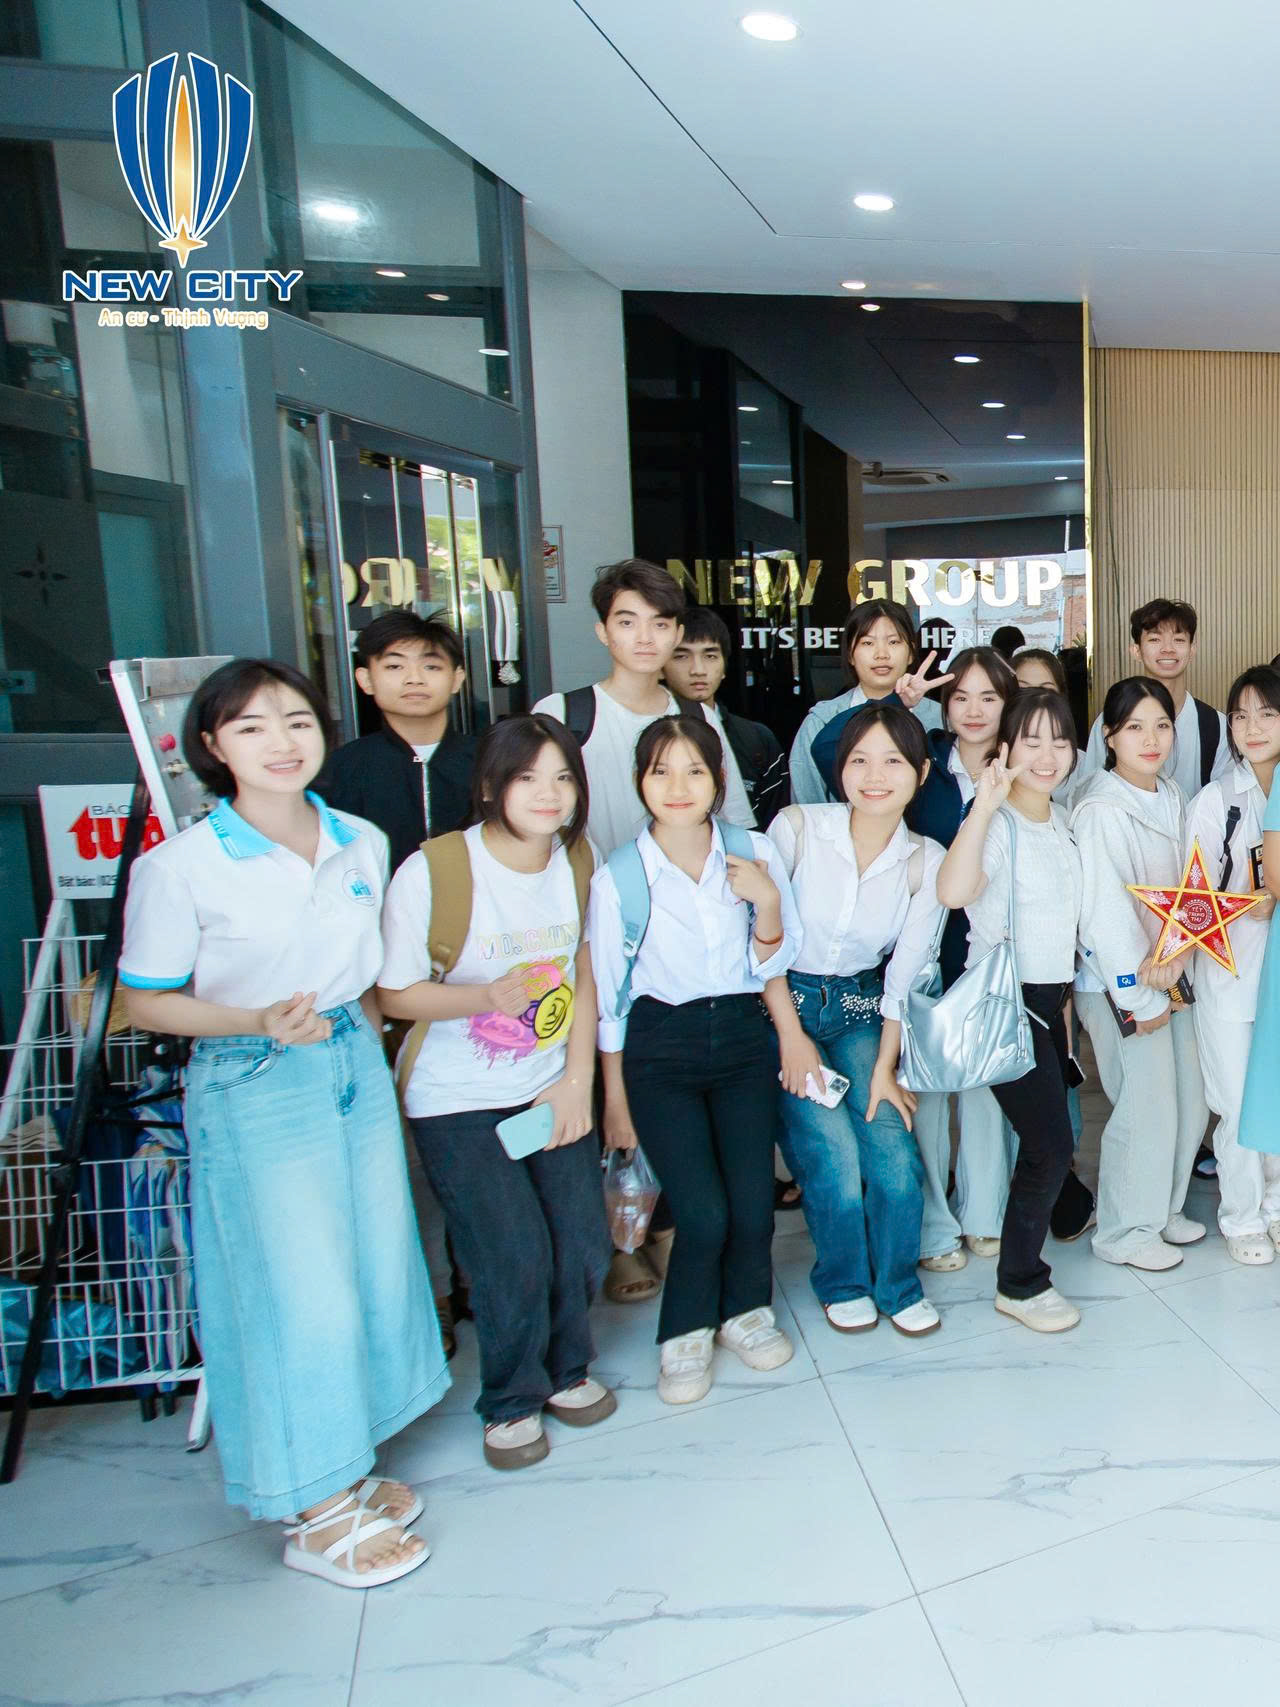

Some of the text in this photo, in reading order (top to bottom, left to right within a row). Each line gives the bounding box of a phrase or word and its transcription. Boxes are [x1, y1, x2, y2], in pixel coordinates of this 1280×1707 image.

[666, 559, 1063, 607] NEW GROUP
[740, 626, 795, 649] IT'S
[920, 627, 992, 649] HERE
